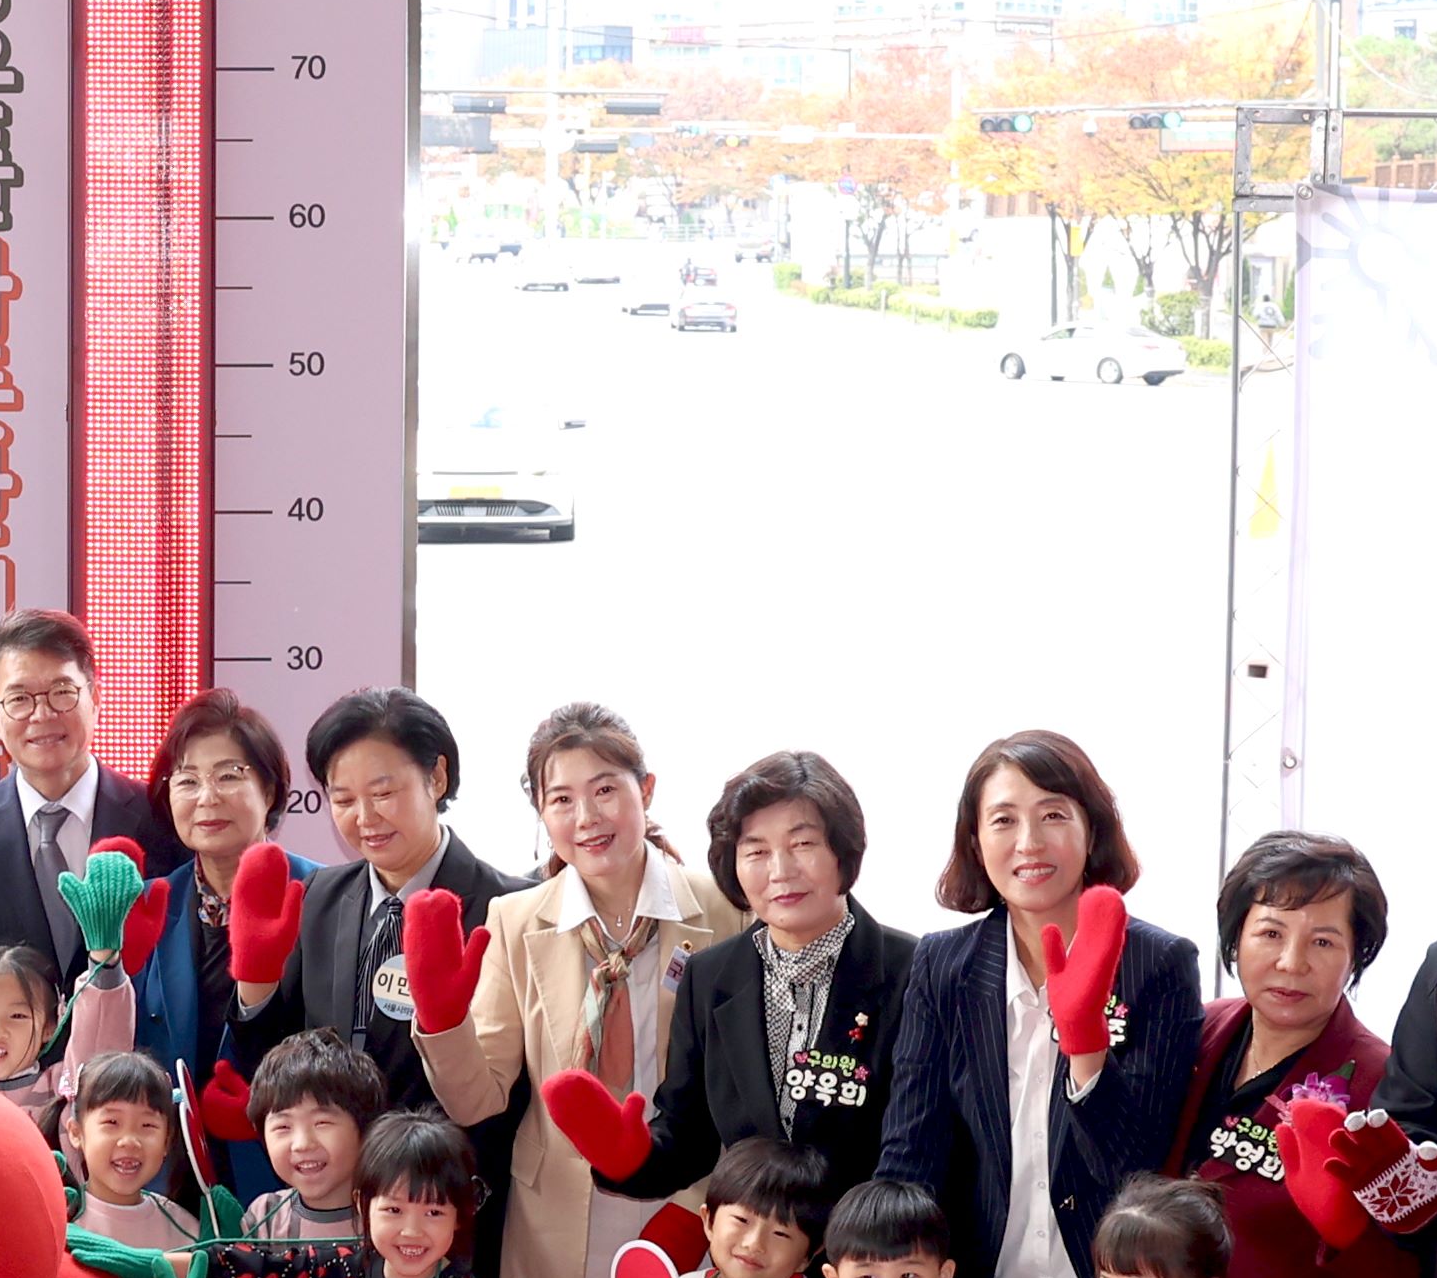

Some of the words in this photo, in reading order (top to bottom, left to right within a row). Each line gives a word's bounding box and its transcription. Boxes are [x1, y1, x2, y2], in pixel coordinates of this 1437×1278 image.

[290, 55, 327, 81] 70
[288, 204, 327, 230] 60
[287, 352, 326, 378] 50
[286, 497, 325, 523] 40
[286, 646, 324, 672] 30
[286, 791, 322, 815] 20
[806, 1049, 857, 1078] 구의원
[785, 1068, 867, 1107] 양옥희
[1209, 1126, 1286, 1183] 박영희
